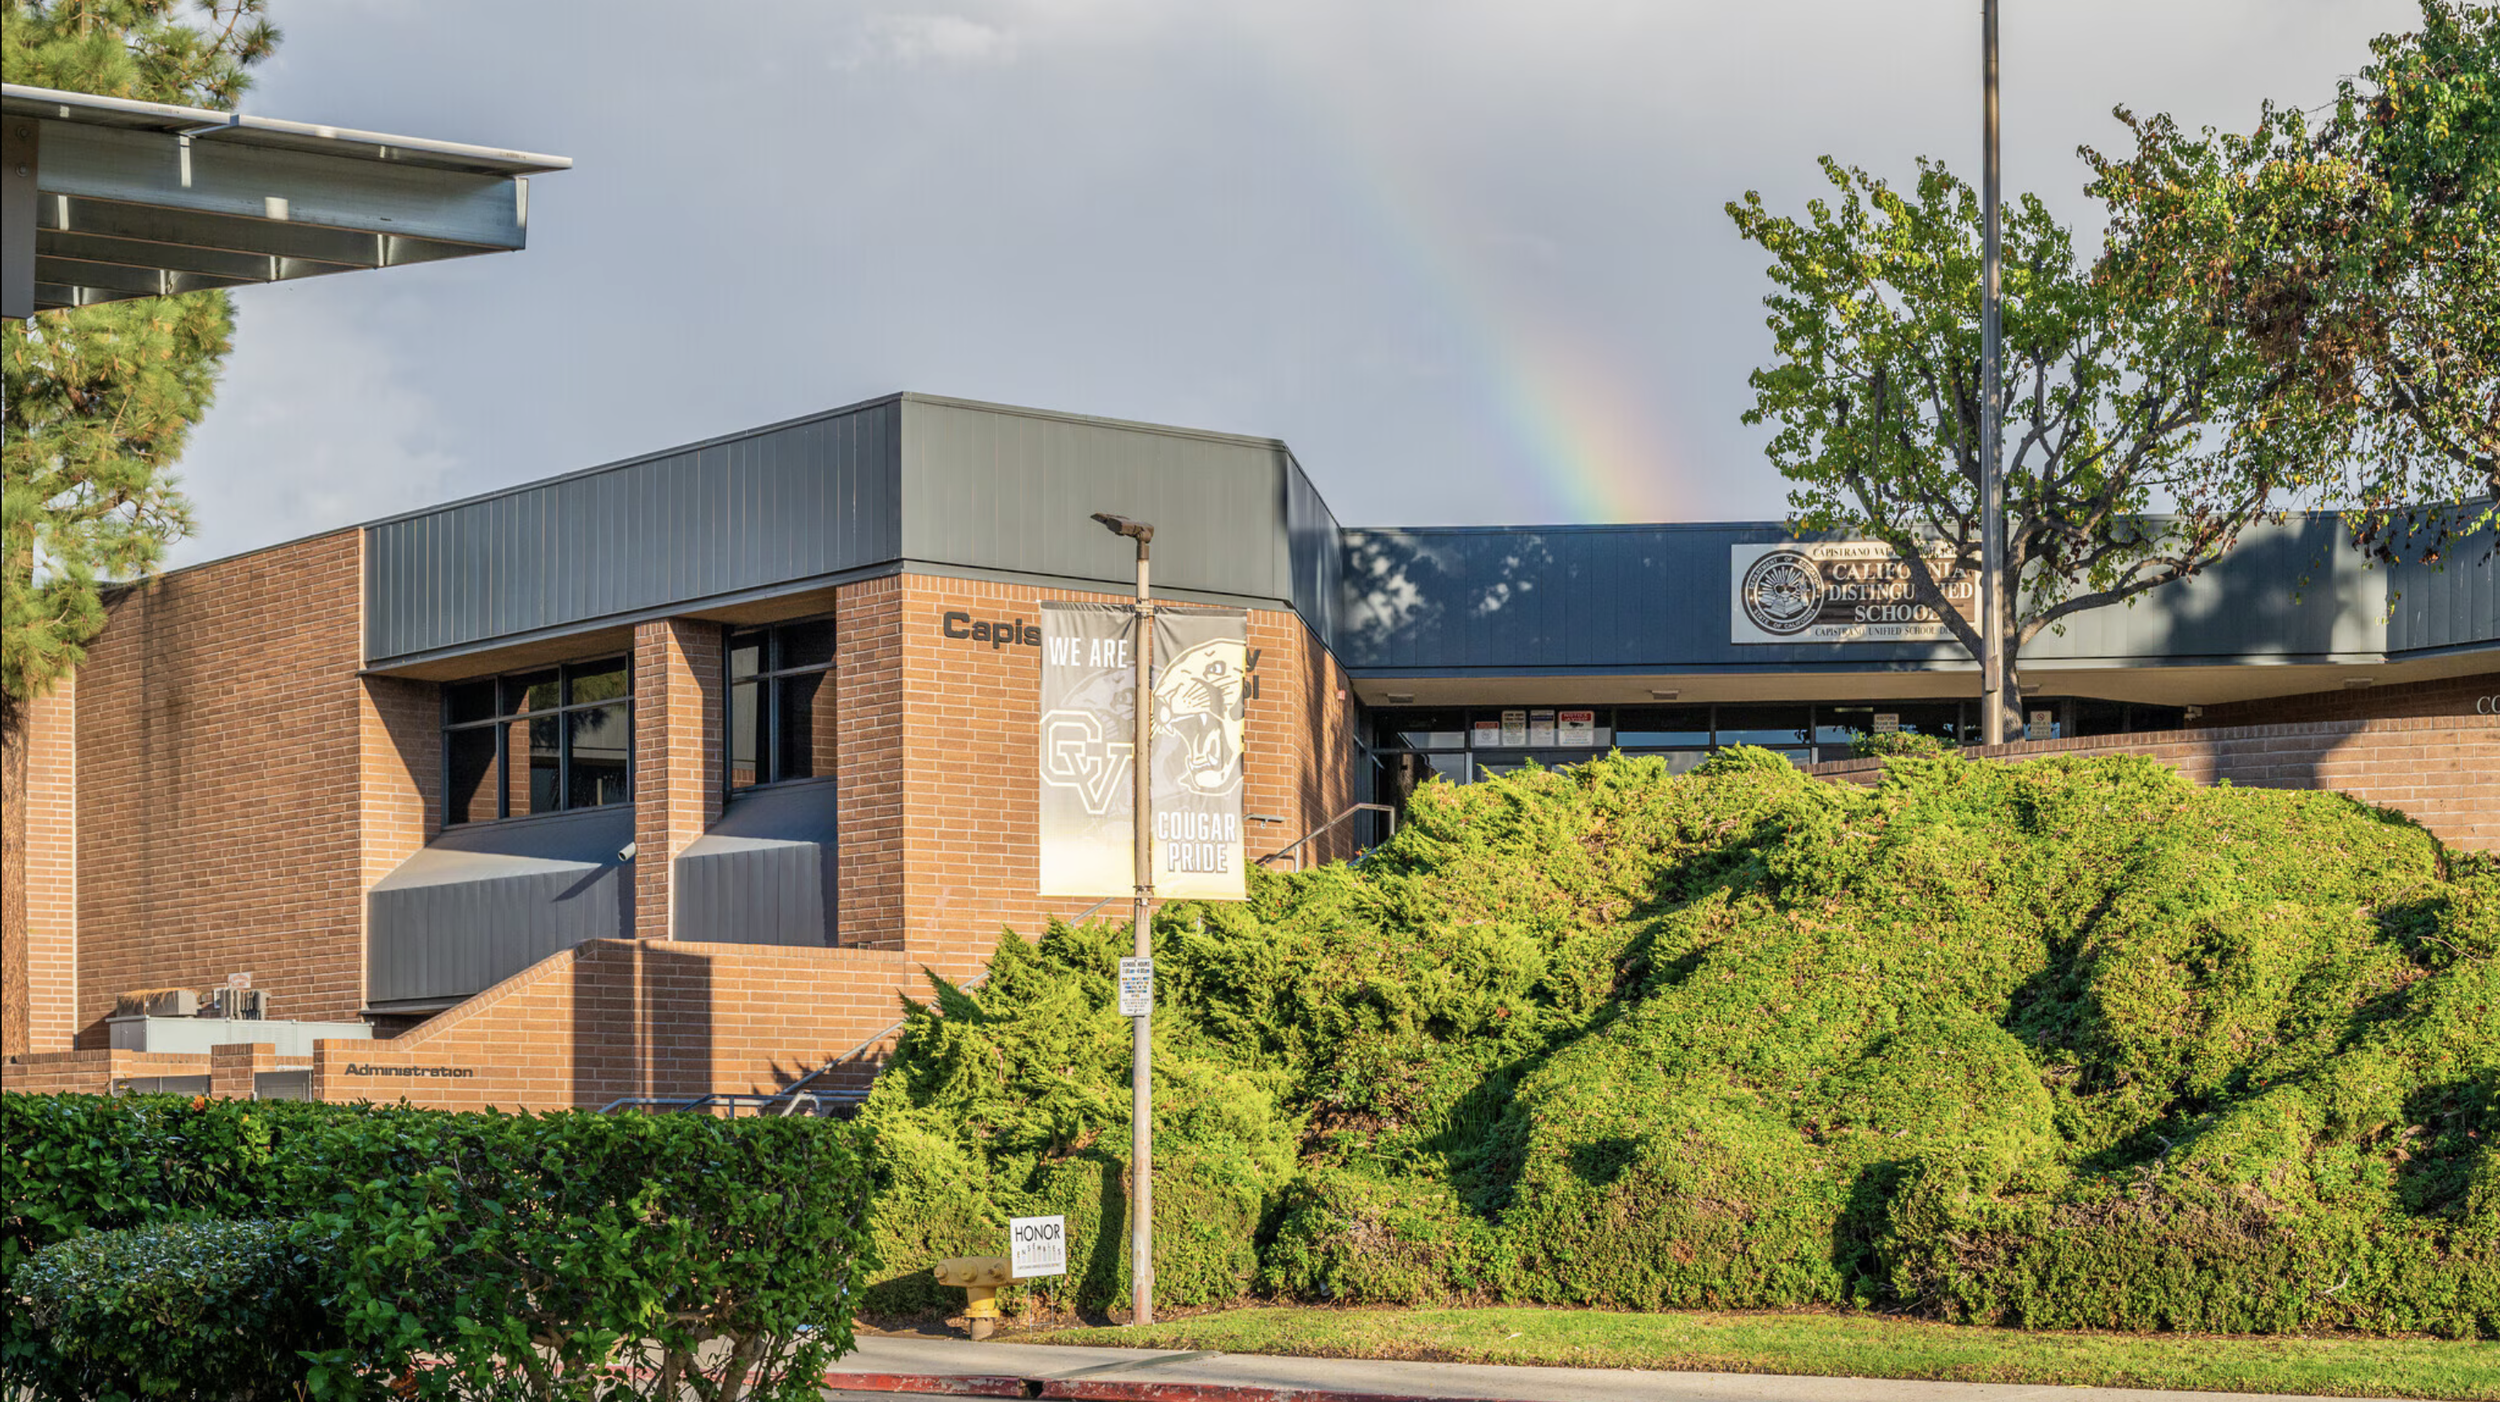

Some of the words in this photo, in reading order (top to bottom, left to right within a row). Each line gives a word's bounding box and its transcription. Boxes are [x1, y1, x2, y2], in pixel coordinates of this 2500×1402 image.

[1813, 547, 1870, 557] CAPISTRANO
[1749, 558, 1778, 590] DEPARTMENT
[1798, 560, 1821, 588] EDUCATION
[1832, 562, 1968, 580] CALIFONIA
[1829, 582, 1973, 600] DISTINGUED
[1753, 609, 1769, 625] STATE
[1784, 608, 1816, 629] CALIFORNIA
[944, 611, 1041, 649] Capis
[1815, 627, 1865, 636] CAPISTRANO
[1868, 626, 1901, 636] UNIFIED
[1904, 625, 1935, 635] SCHOOL
[1048, 636, 1081, 667] WE
[1089, 638, 1128, 668] ARE
[1040, 709, 1134, 815] CV
[1157, 811, 1237, 842] COUGAR
[1168, 842, 1228, 874] PRIDE
[344, 1063, 473, 1077] Administration
[1015, 1224, 1060, 1242] HONOR
